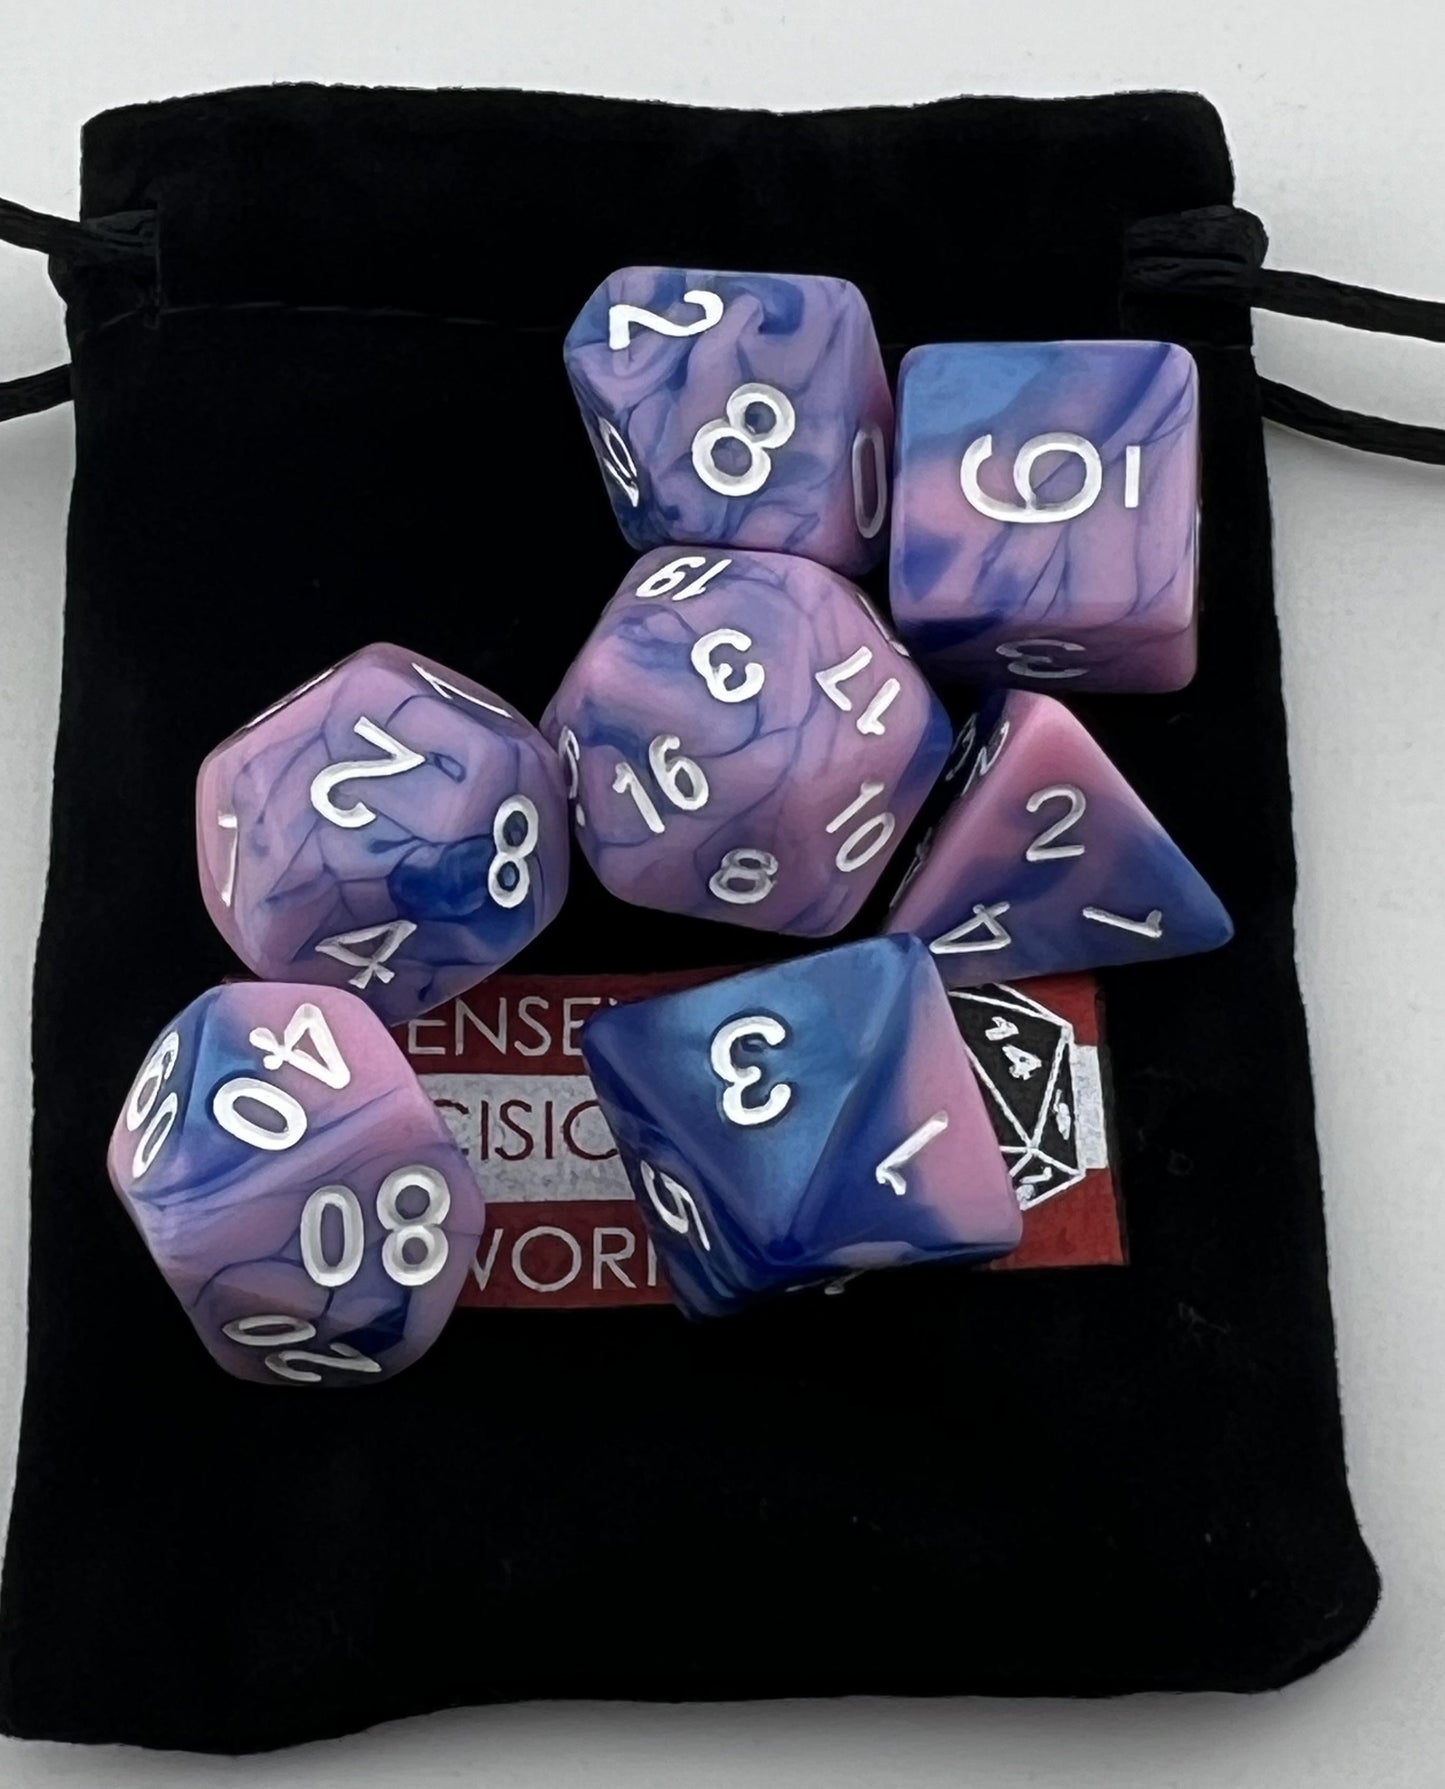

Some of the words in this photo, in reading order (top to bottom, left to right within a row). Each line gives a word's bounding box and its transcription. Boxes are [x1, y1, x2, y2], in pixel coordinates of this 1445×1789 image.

[609, 289, 724, 351] 2
[692, 382, 795, 497] 8
[851, 423, 887, 540] 0
[691, 627, 766, 704] 3
[310, 717, 425, 829] 2
[612, 734, 709, 834] 16
[487, 794, 540, 910] 8
[825, 781, 896, 874] 10
[1025, 783, 1087, 862] 2
[708, 847, 779, 905] 8
[1082, 905, 1164, 940] 1
[314, 919, 417, 990] 4
[930, 902, 1012, 955] 4
[212, 1002, 351, 1152] 40
[710, 1015, 792, 1126] 3
[875, 1110, 950, 1196] 1
[299, 1164, 451, 1288] 80
